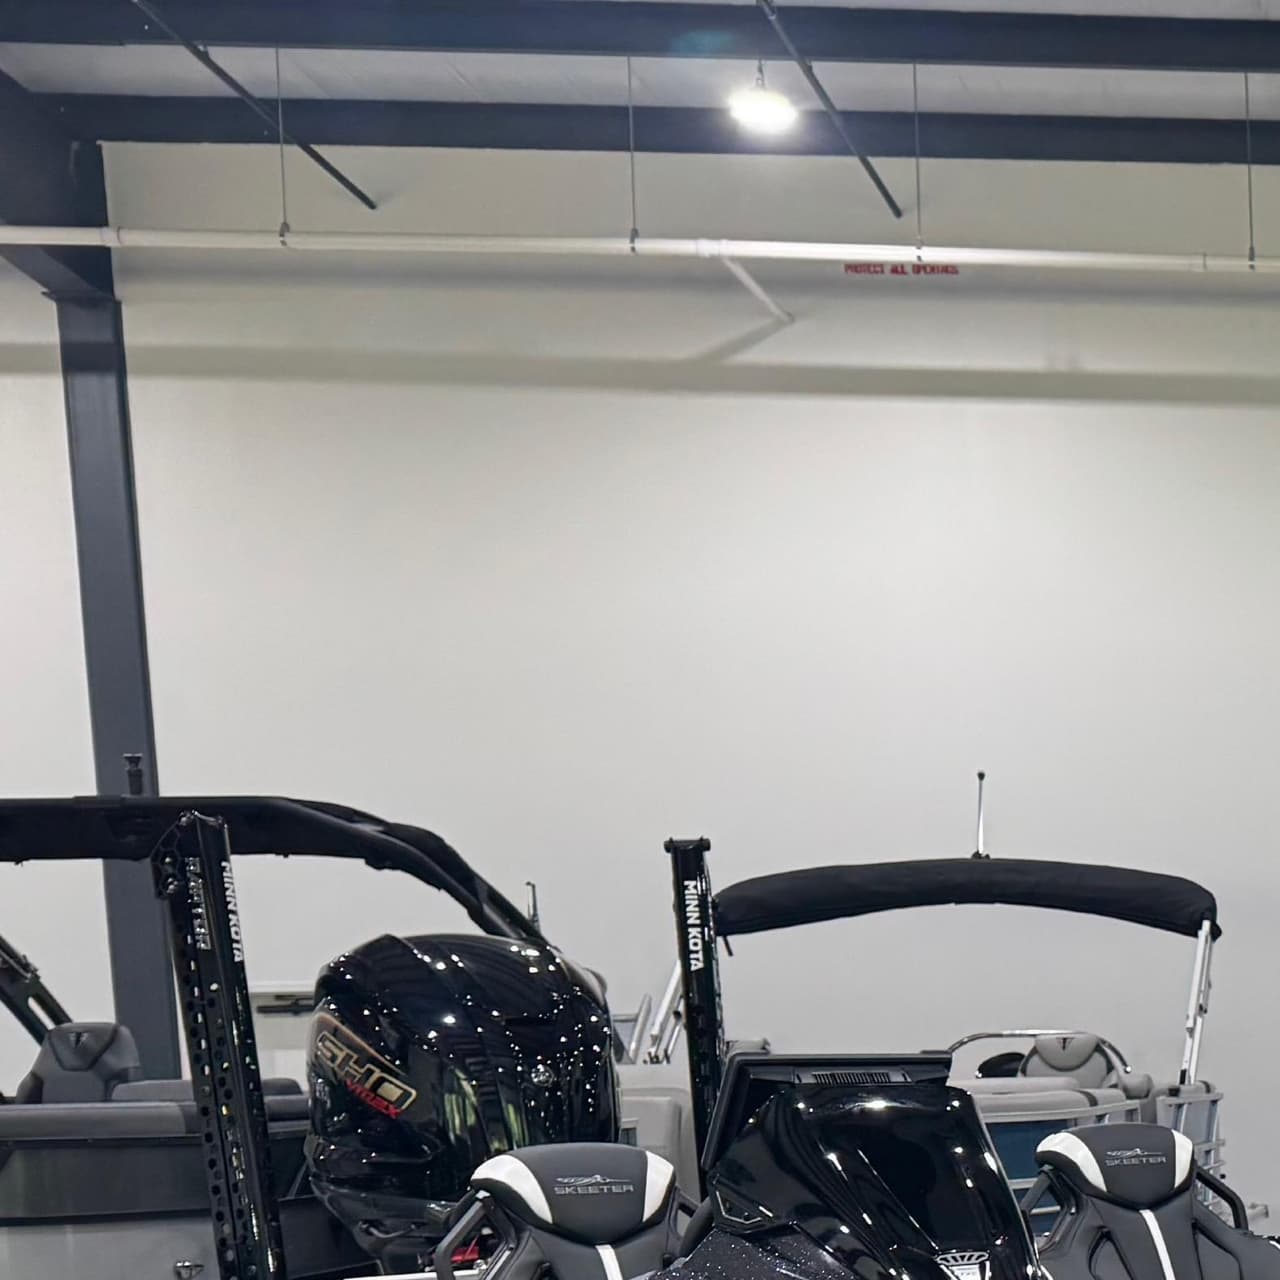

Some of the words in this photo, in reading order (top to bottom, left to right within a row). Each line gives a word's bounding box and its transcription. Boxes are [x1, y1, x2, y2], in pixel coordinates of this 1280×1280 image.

[221, 860, 238, 911] MINN
[683, 880, 702, 925] MINN
[228, 913, 244, 963] KOTA
[687, 926, 705, 972] KOTA
[316, 1031, 417, 1112] SHO
[1105, 1155, 1167, 1168] SKEETER
[553, 1184, 635, 1196] SKEETER
